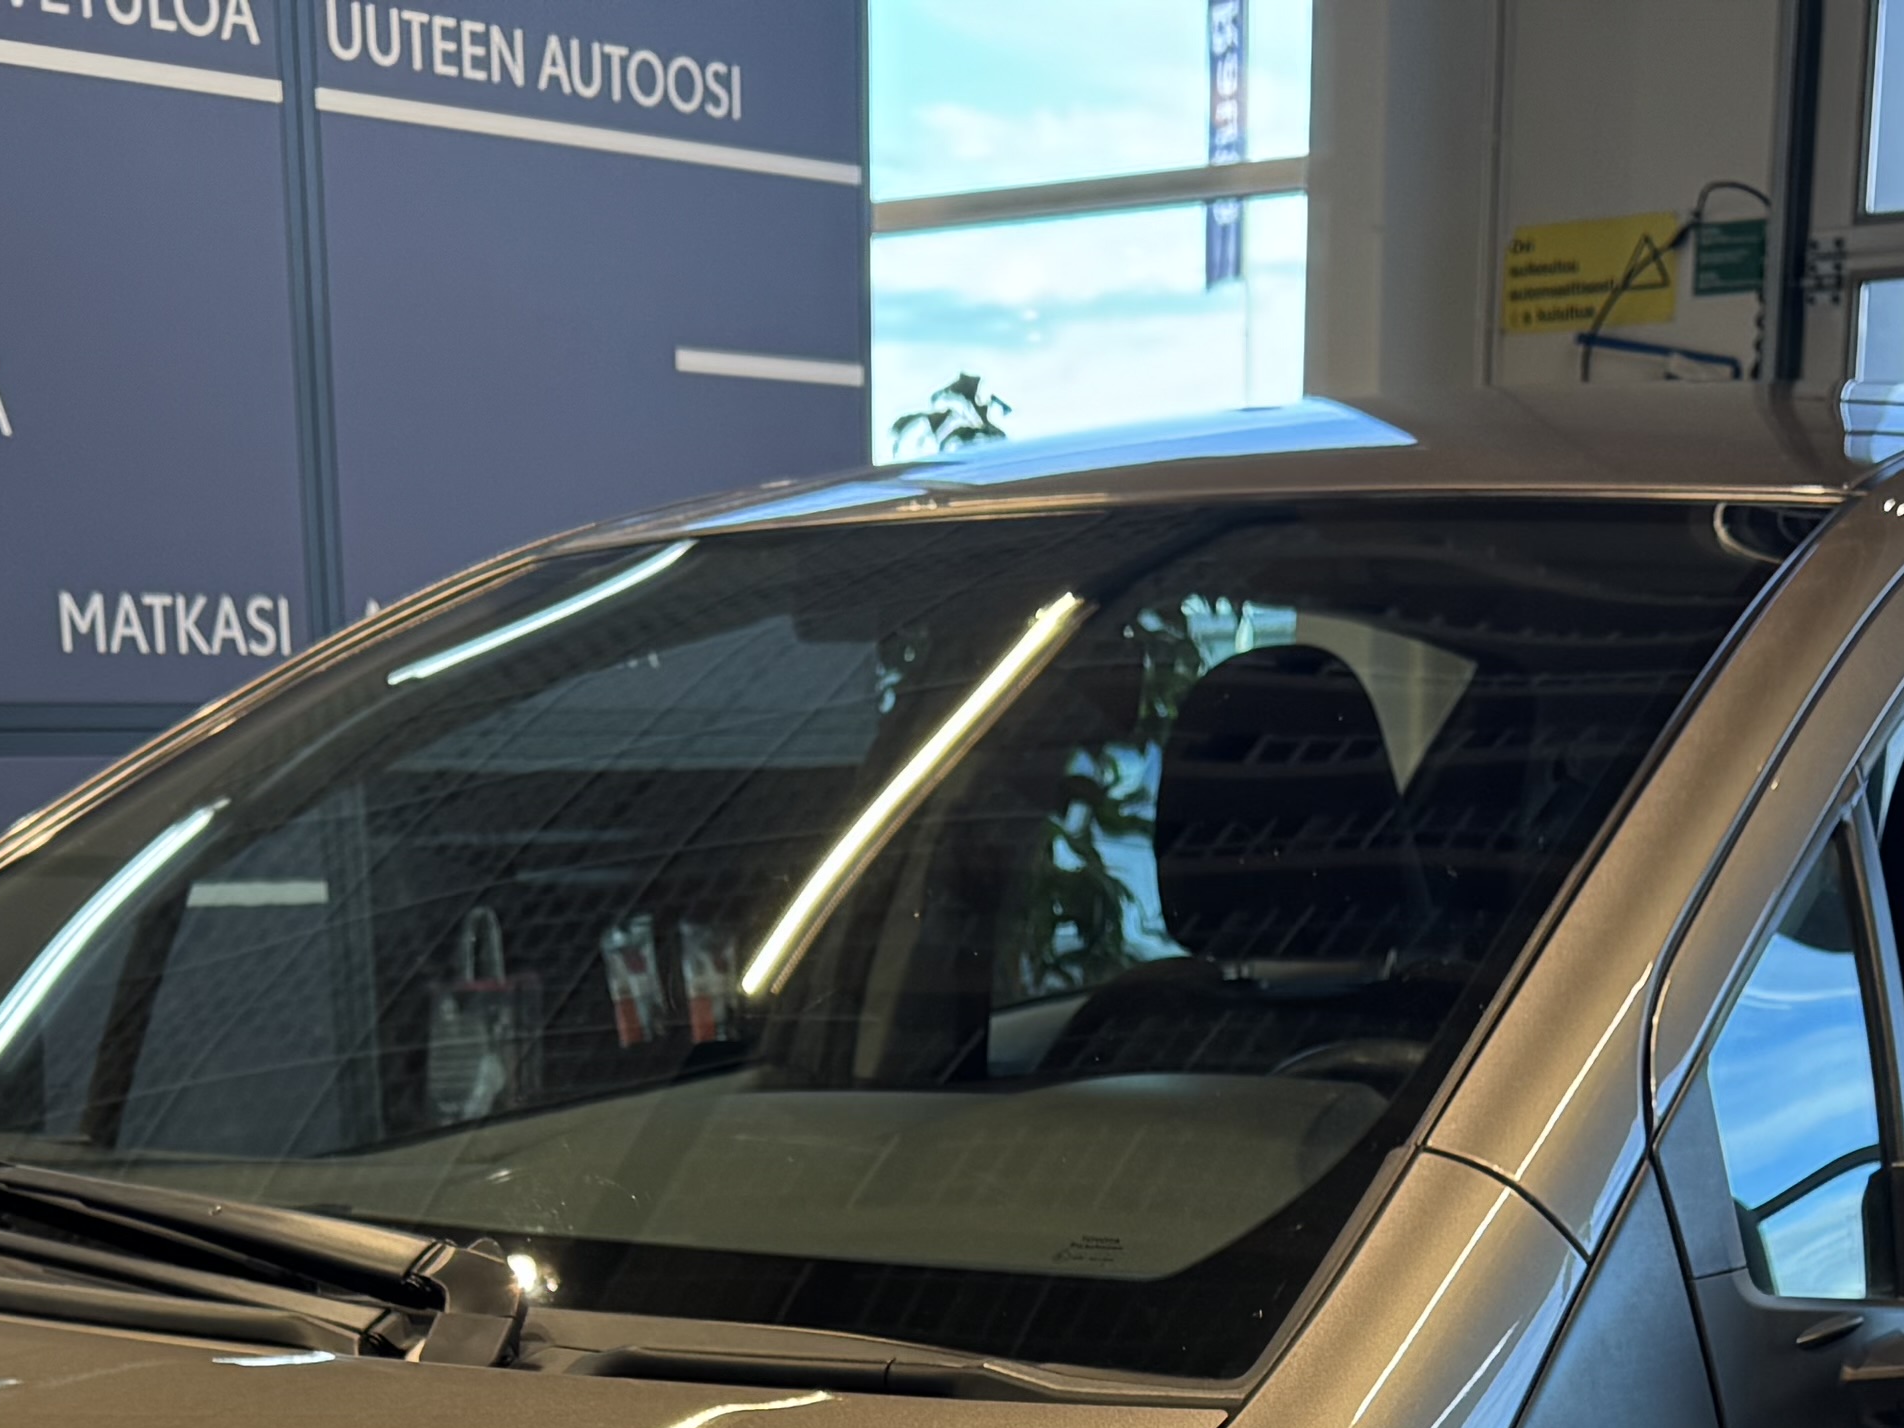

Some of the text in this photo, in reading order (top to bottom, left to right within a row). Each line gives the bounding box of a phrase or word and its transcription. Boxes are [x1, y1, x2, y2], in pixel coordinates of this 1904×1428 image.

[326, 0, 525, 88] UUTEEN
[537, 33, 742, 121] AUTOOSI
[58, 590, 293, 657] MATKASI
